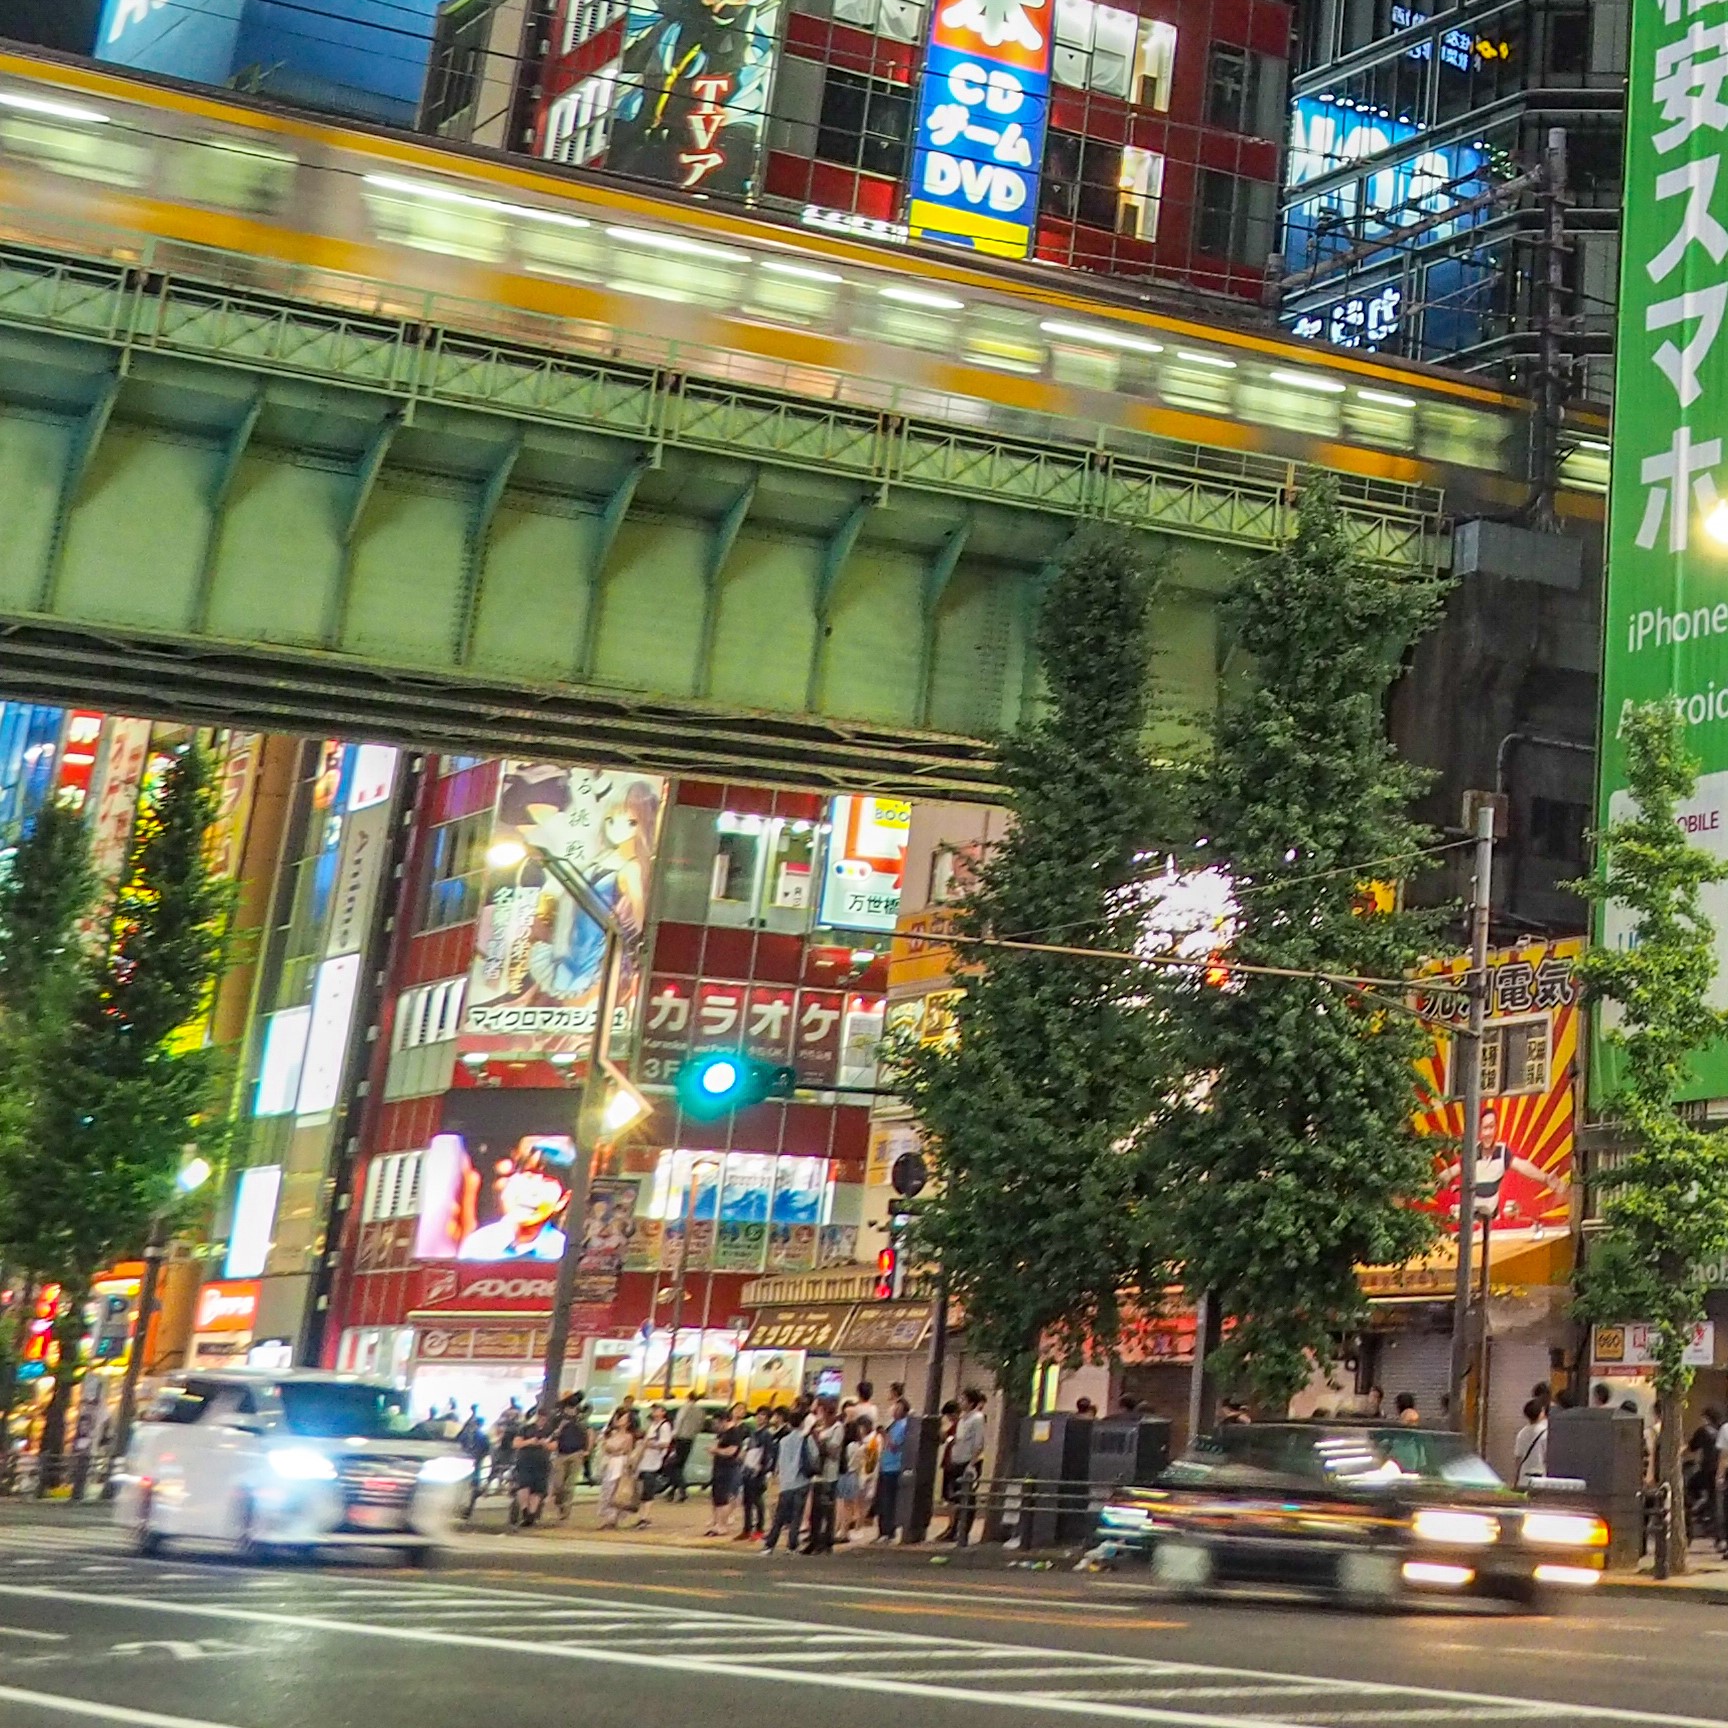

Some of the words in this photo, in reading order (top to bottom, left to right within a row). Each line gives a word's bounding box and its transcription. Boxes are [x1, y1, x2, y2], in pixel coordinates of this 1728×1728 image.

[948, 63, 1024, 116] CD
[927, 102, 1033, 170] ゲーム
[922, 151, 1027, 214] DVD
[649, 989, 841, 1044] カラオケ
[644, 1057, 682, 1080] 3F
